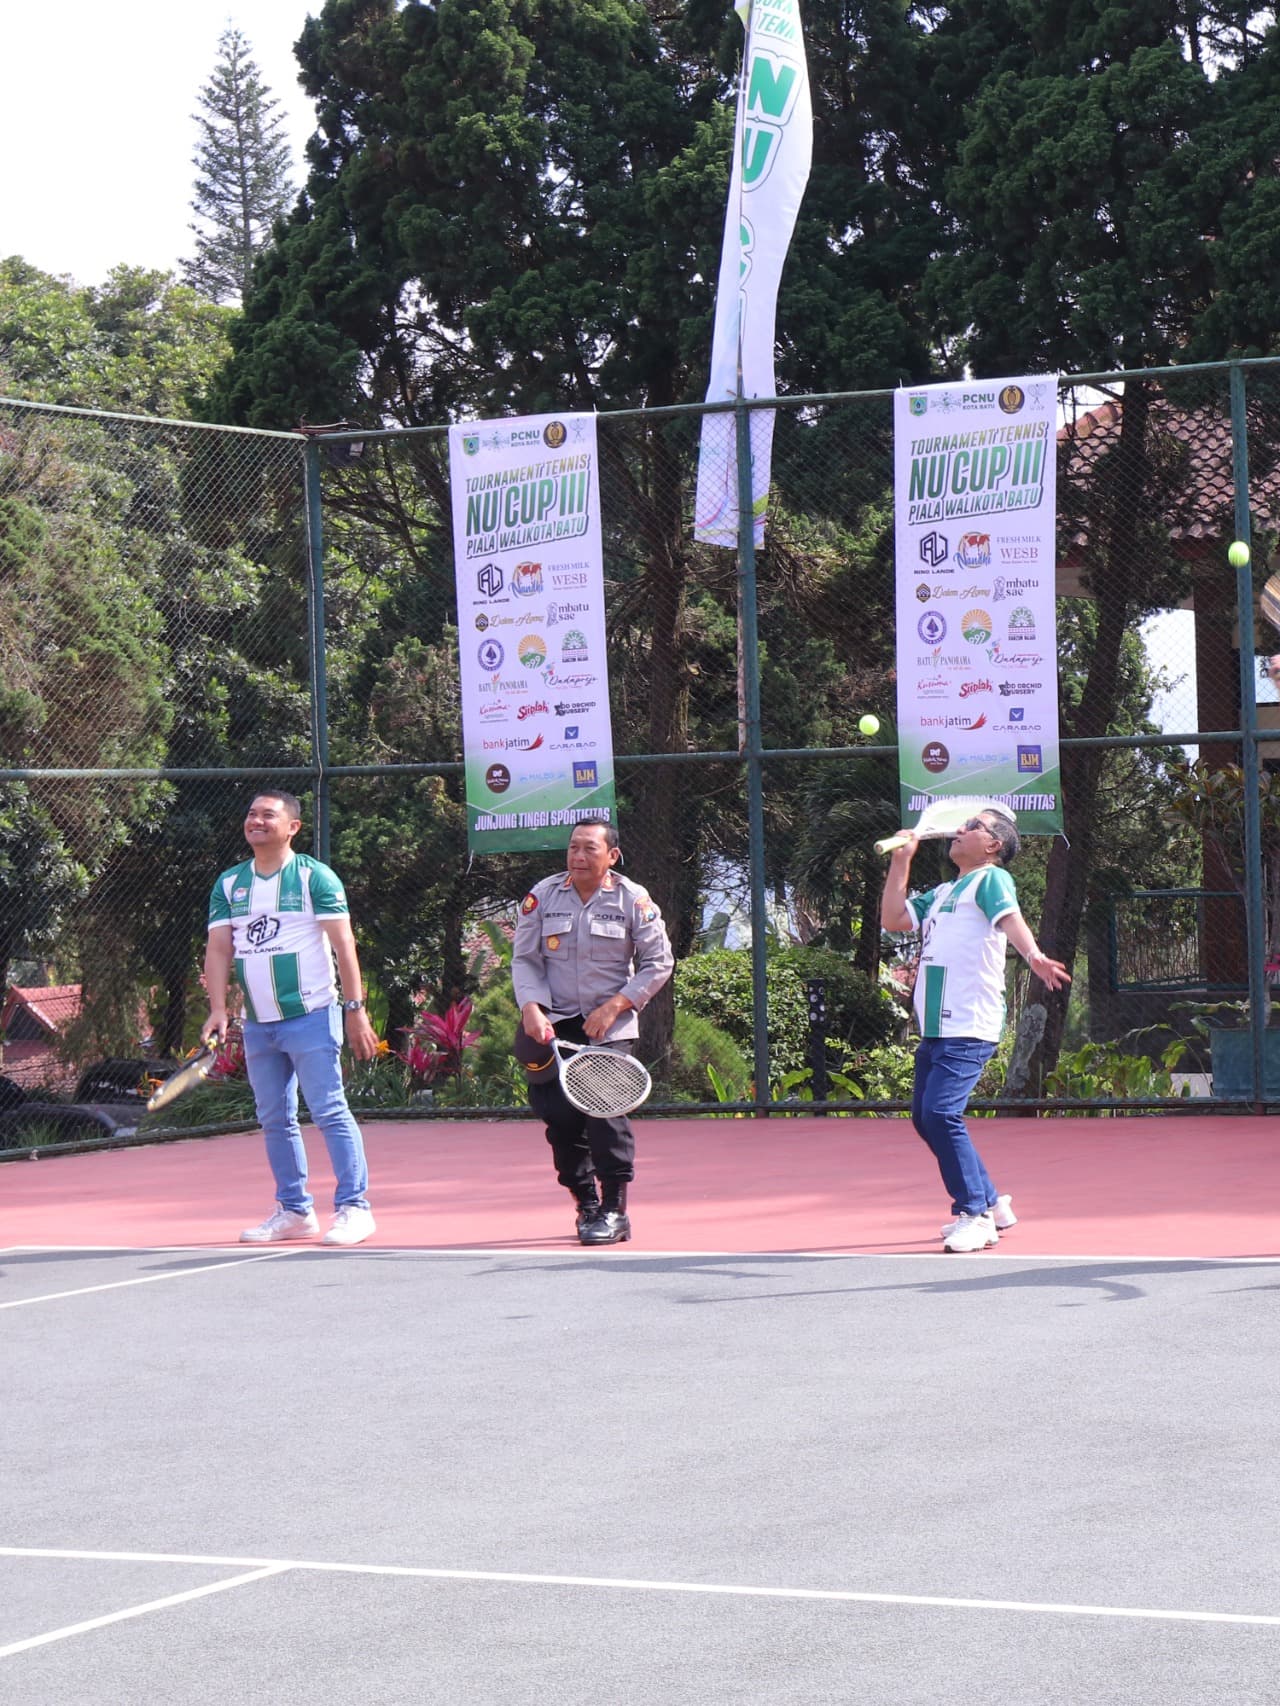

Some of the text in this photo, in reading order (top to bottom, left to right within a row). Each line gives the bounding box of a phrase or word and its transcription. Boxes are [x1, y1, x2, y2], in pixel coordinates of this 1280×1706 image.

[963, 393, 995, 403] PCNU
[511, 430, 540, 441] PCNU
[911, 421, 1046, 456] TOURNAMENT TENNIS
[466, 454, 588, 494] TOURNAMENT TENNIS
[909, 440, 1043, 501] NU CUP III
[466, 471, 586, 537] NU CUP III
[909, 488, 1039, 522] PIALA WALIKOTA BATU
[467, 517, 585, 556] PIALA WALIKOTA BATU
[1000, 548, 1038, 558] WESB
[571, 561, 590, 569] MILK
[552, 574, 588, 585] WESB
[1006, 578, 1039, 588] mbatu
[920, 713, 972, 728] bankjatim
[475, 813, 517, 831] JUNJUNG
[519, 811, 549, 828] TINGGI
